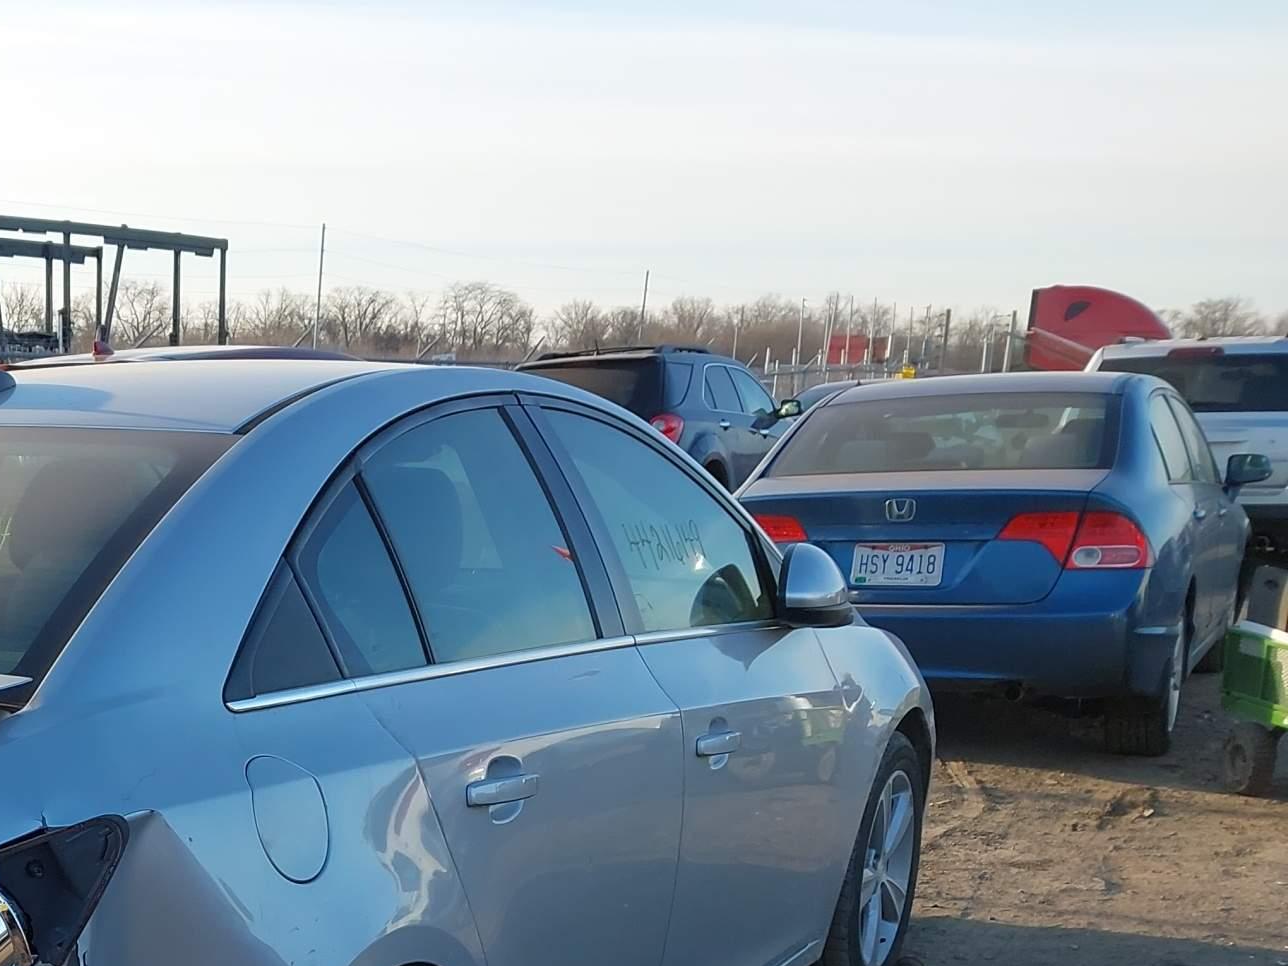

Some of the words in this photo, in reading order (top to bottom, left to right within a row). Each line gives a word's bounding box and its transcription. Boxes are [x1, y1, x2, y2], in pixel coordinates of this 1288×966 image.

[888, 544, 911, 552] OHIO
[859, 553, 890, 575] HSY
[895, 553, 937, 575] 9418
